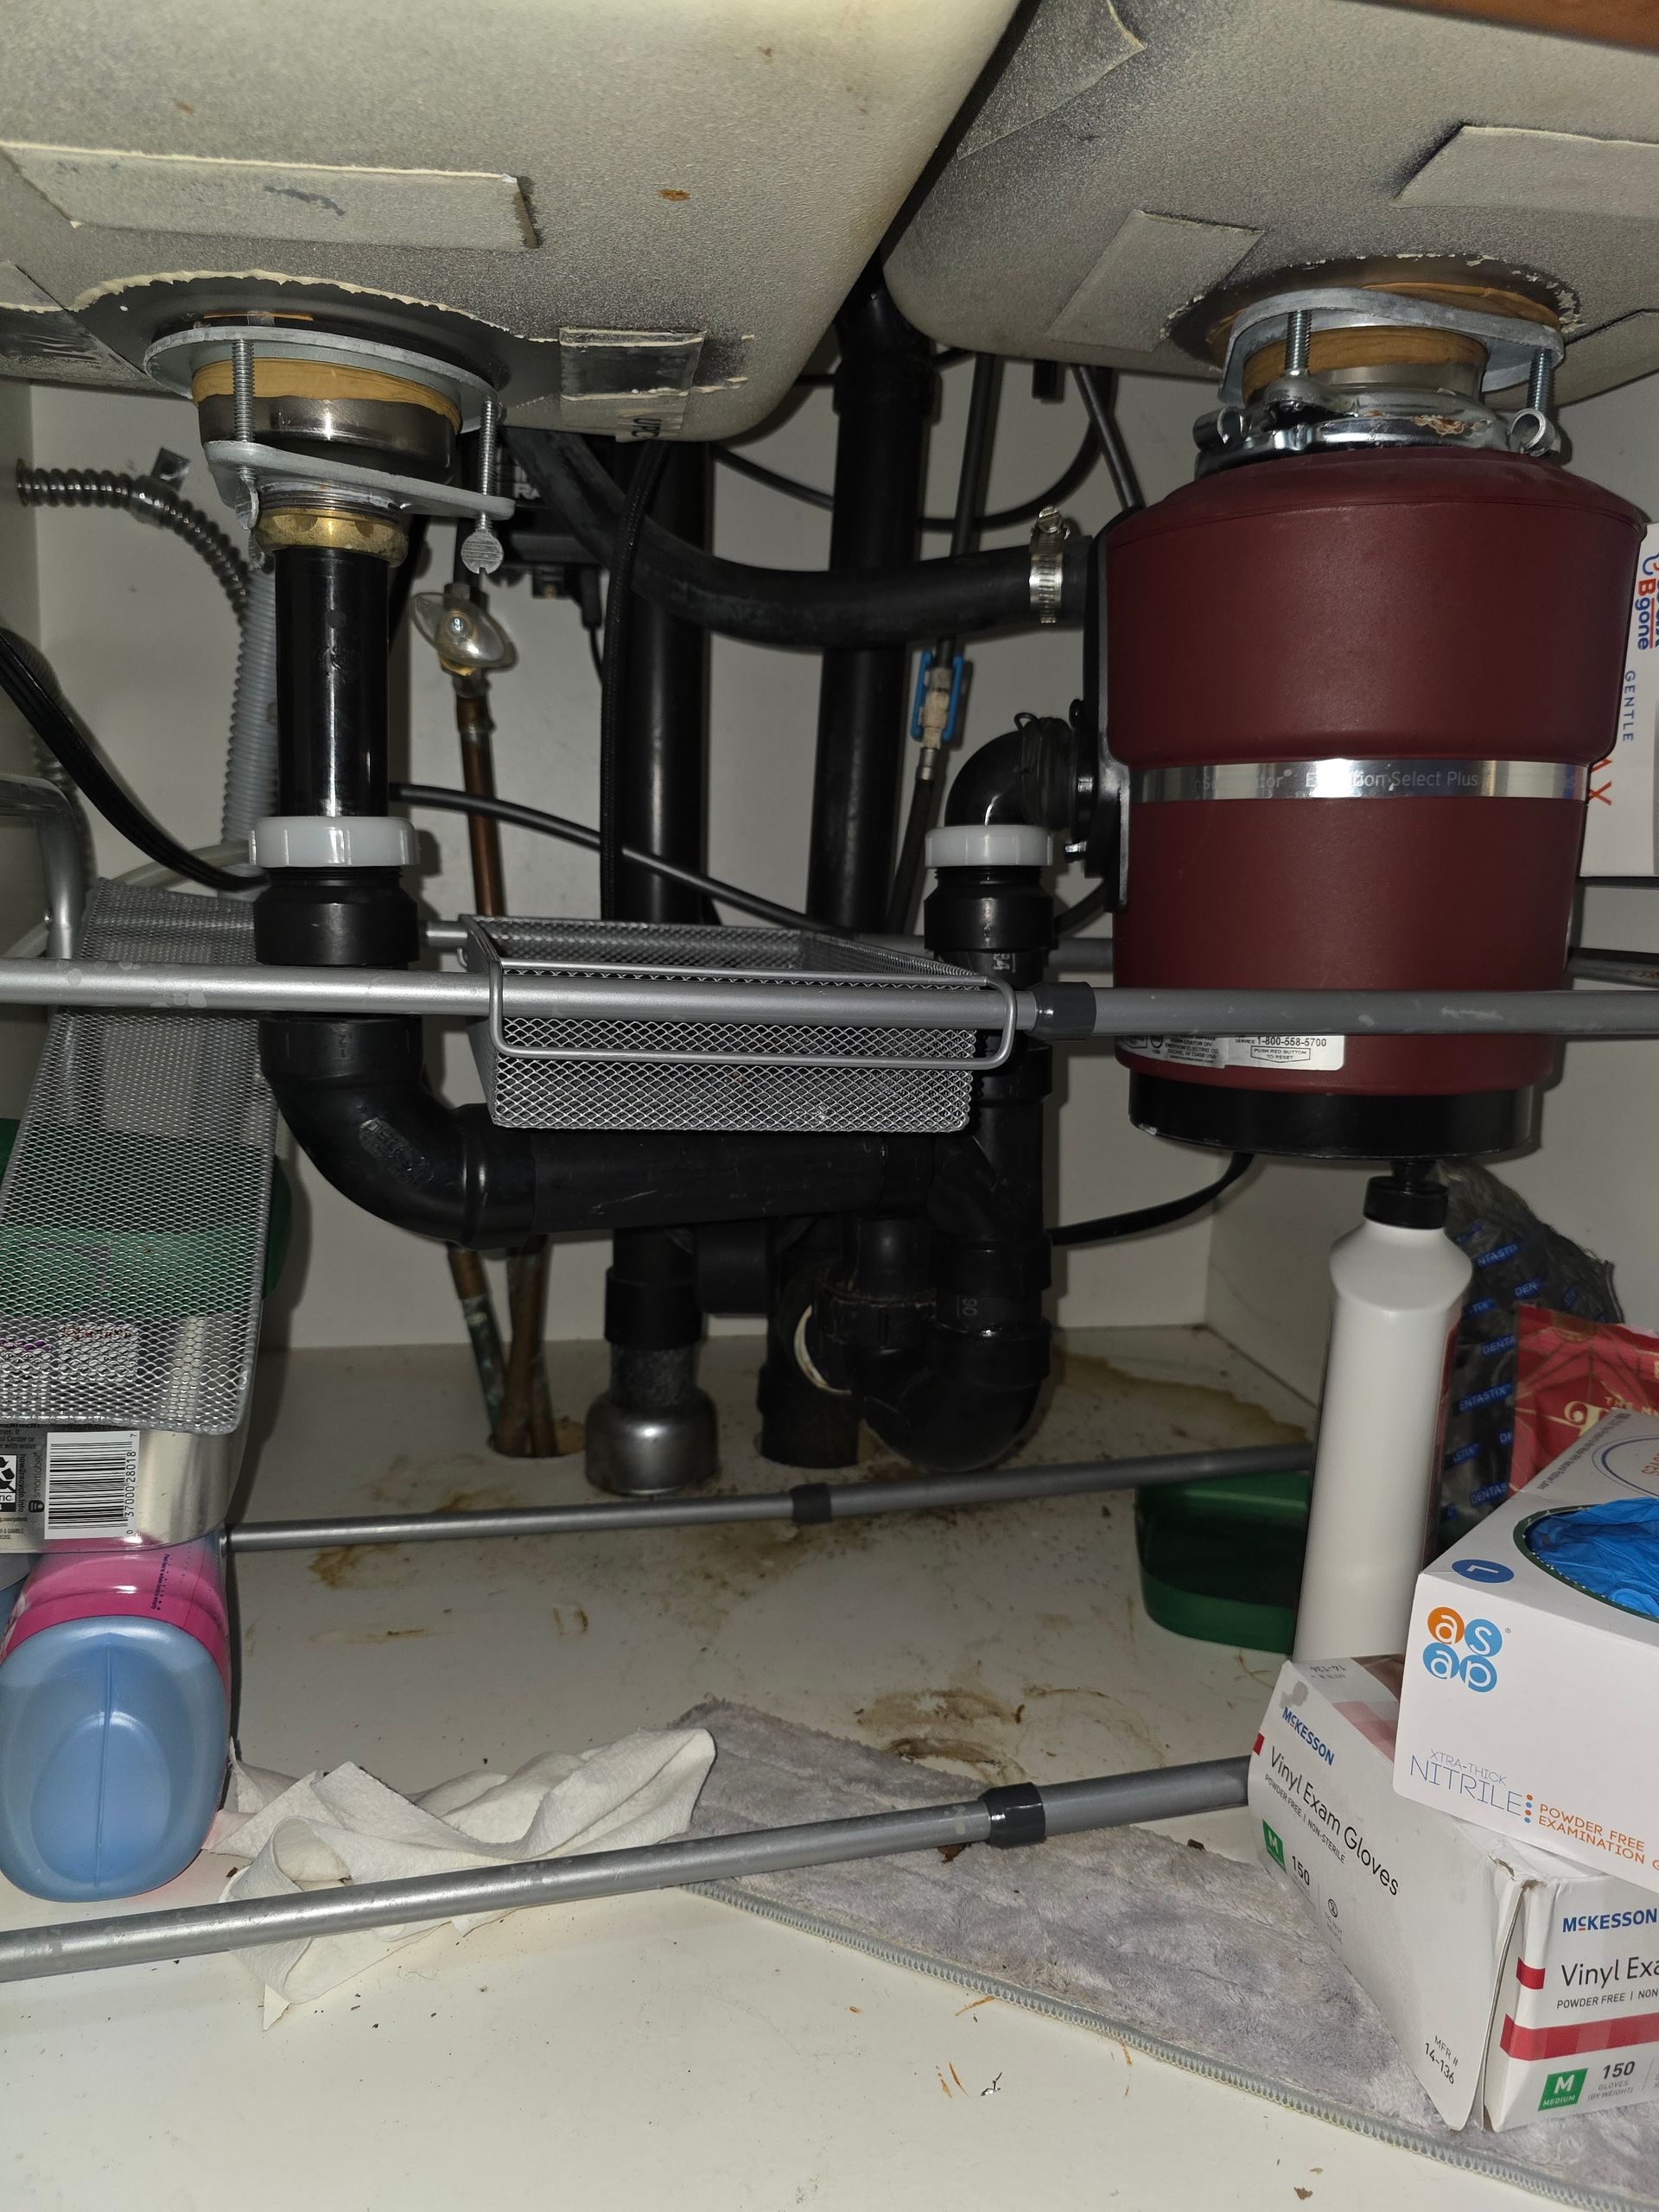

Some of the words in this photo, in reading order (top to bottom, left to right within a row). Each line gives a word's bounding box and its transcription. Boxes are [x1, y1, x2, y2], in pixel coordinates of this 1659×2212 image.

[1635, 578, 1656, 651] Bgone
[1623, 670, 1636, 742] GENTLE
[1391, 771, 1441, 786] Select
[1446, 771, 1478, 786] Plus
[1256, 1037, 1326, 1046] 1-800-558-5700
[17, 1453, 28, 1512] how2recycle.info
[126, 1451, 137, 1483] 28018
[124, 1485, 136, 1517] 37000
[1430, 1749, 1507, 1786] XTRA-THICK
[1409, 1754, 1522, 1816] NITRILE
[1264, 1774, 1288, 1804] POWDER
[1287, 1799, 1303, 1817] FREE
[1307, 1820, 1346, 1865] NON-STERILE
[1270, 1745, 1302, 1795] Vinyl
[1303, 1782, 1340, 1835] Exam
[1344, 1826, 1399, 1896] Gloves
[1540, 1803, 1603, 1836] POWDER
[1609, 1830, 1645, 1853] FREE
[1268, 1829, 1279, 1854] M
[1538, 1815, 1645, 1865] EXAMINATION
[1292, 1855, 1311, 1886] 150
[1560, 1959, 1619, 1989] Vinyl
[1556, 1995, 1599, 2009] POWDER
[1601, 1993, 1626, 2005] FREE
[1637, 1988, 1659, 1999] NON
[1434, 2035, 1452, 2060] MFR
[1425, 2043, 1455, 2085] 14-136
[1602, 2061, 1636, 2080] 150
[1554, 2074, 1574, 2094] M
[1598, 2080, 1630, 2091] GLOVES
[1542, 2094, 1575, 2107] MEDIUM
